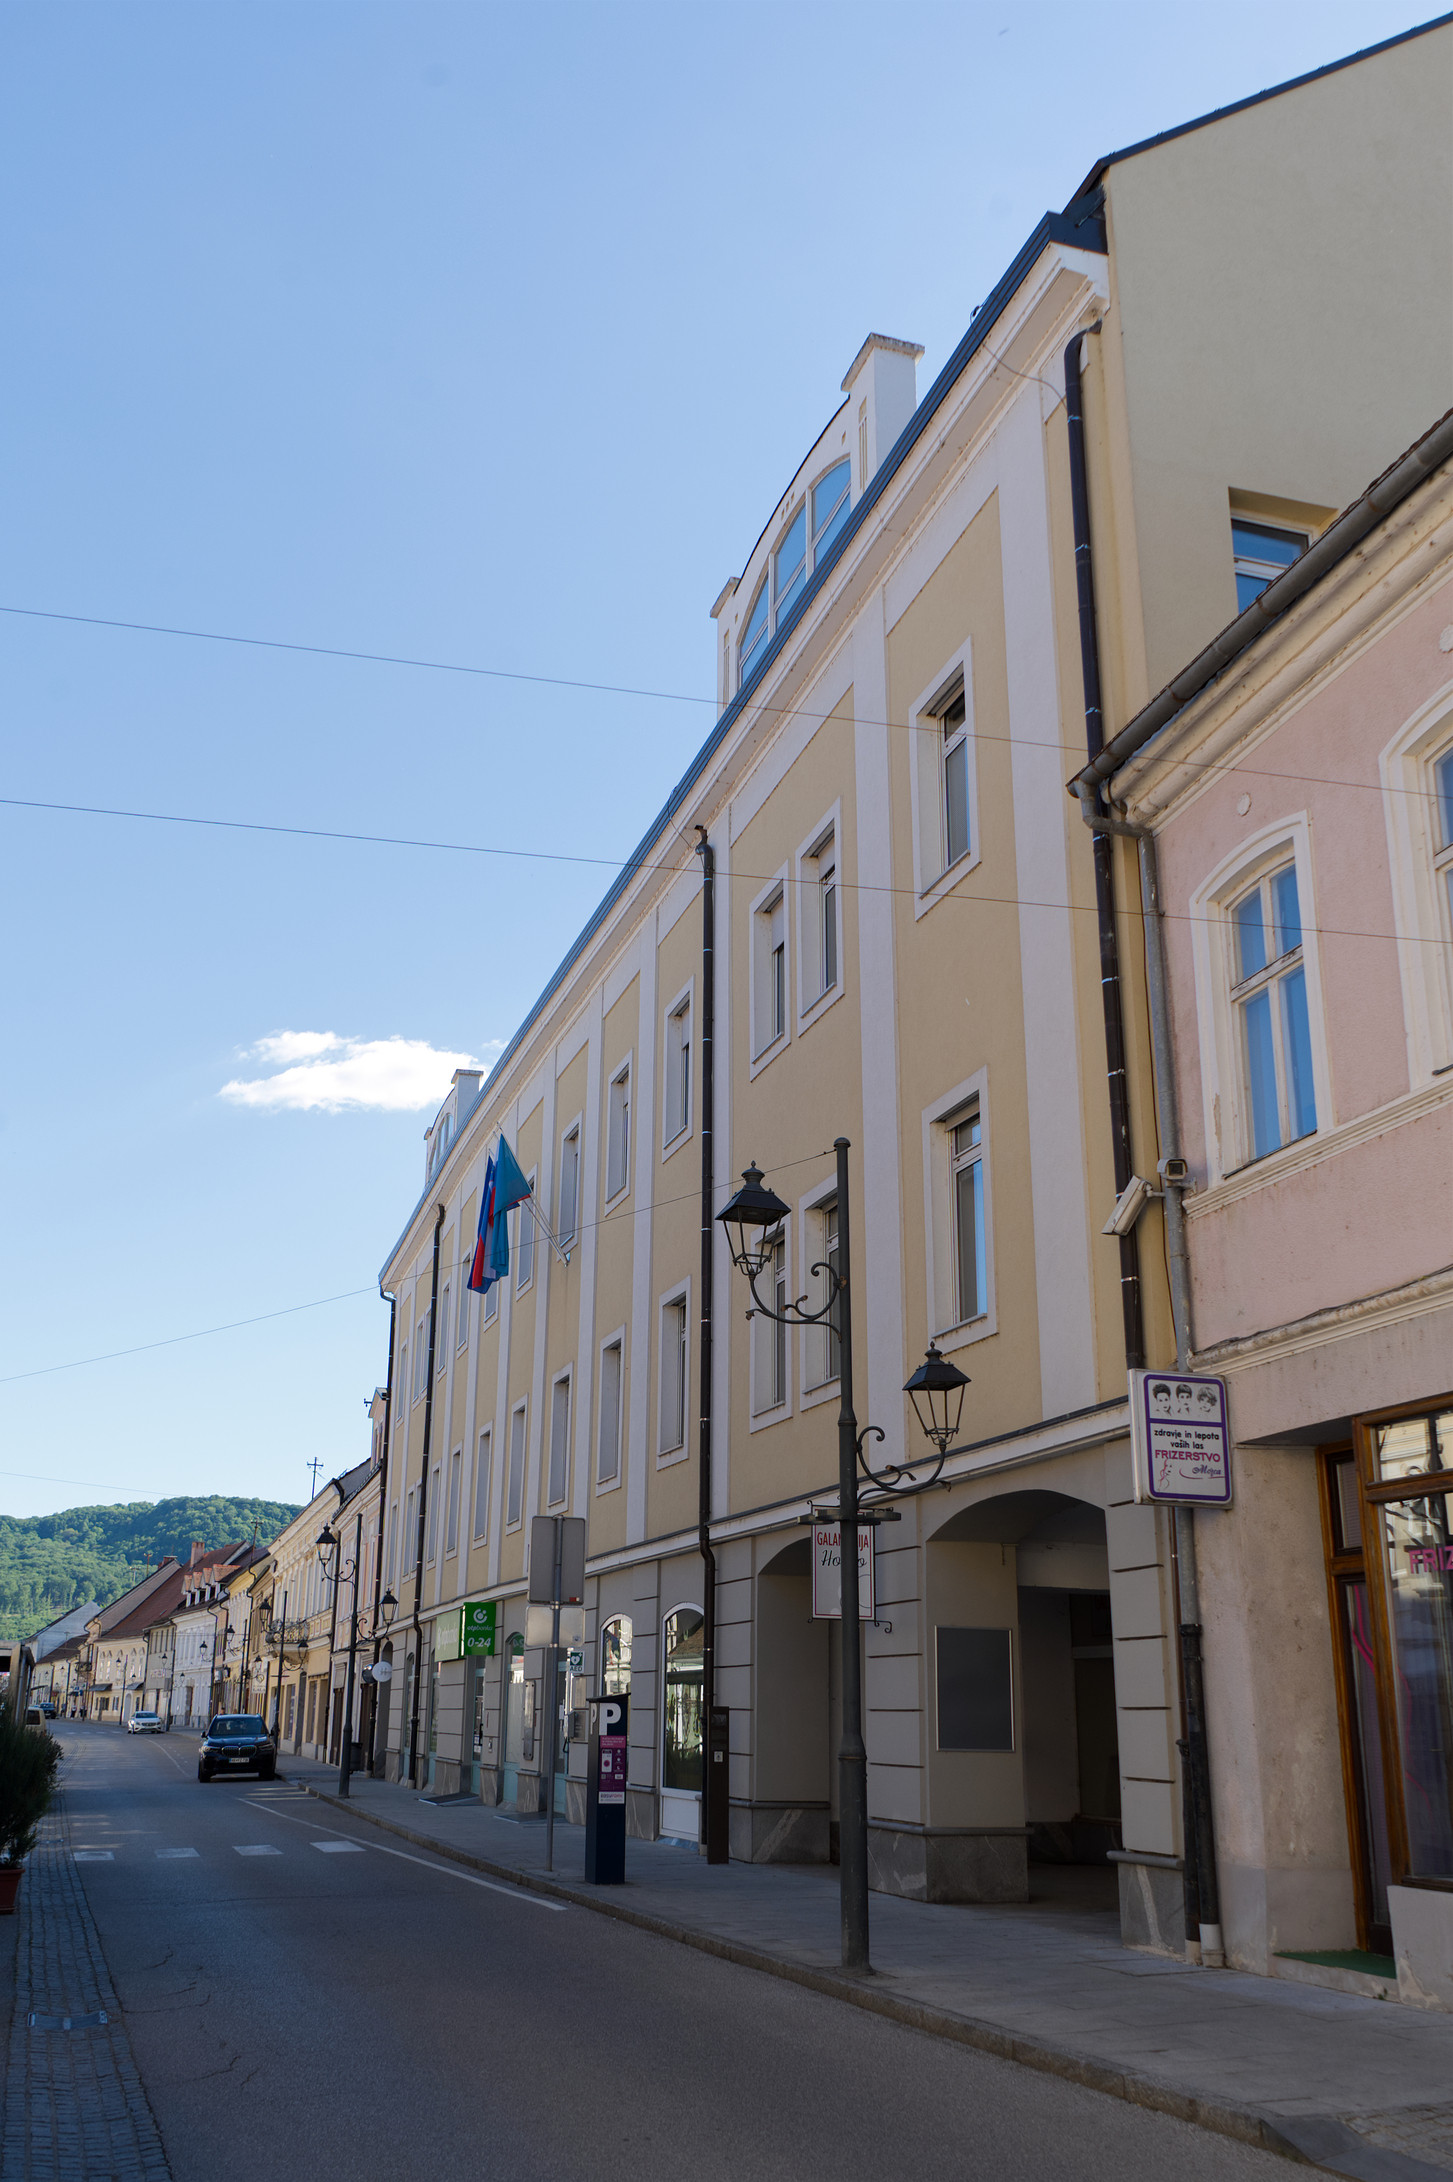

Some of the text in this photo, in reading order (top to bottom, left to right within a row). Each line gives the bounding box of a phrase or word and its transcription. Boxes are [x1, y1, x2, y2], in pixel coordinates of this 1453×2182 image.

[1154, 1428, 1220, 1441] zdravje in lepota
[1170, 1439, 1204, 1450] vaših las
[1155, 1449, 1221, 1463] FRIZERSTVO
[817, 1531, 869, 1552] GALAIJA
[467, 1637, 492, 1648] 0-24
[590, 1702, 598, 1735] P
[599, 1702, 621, 1736] P
